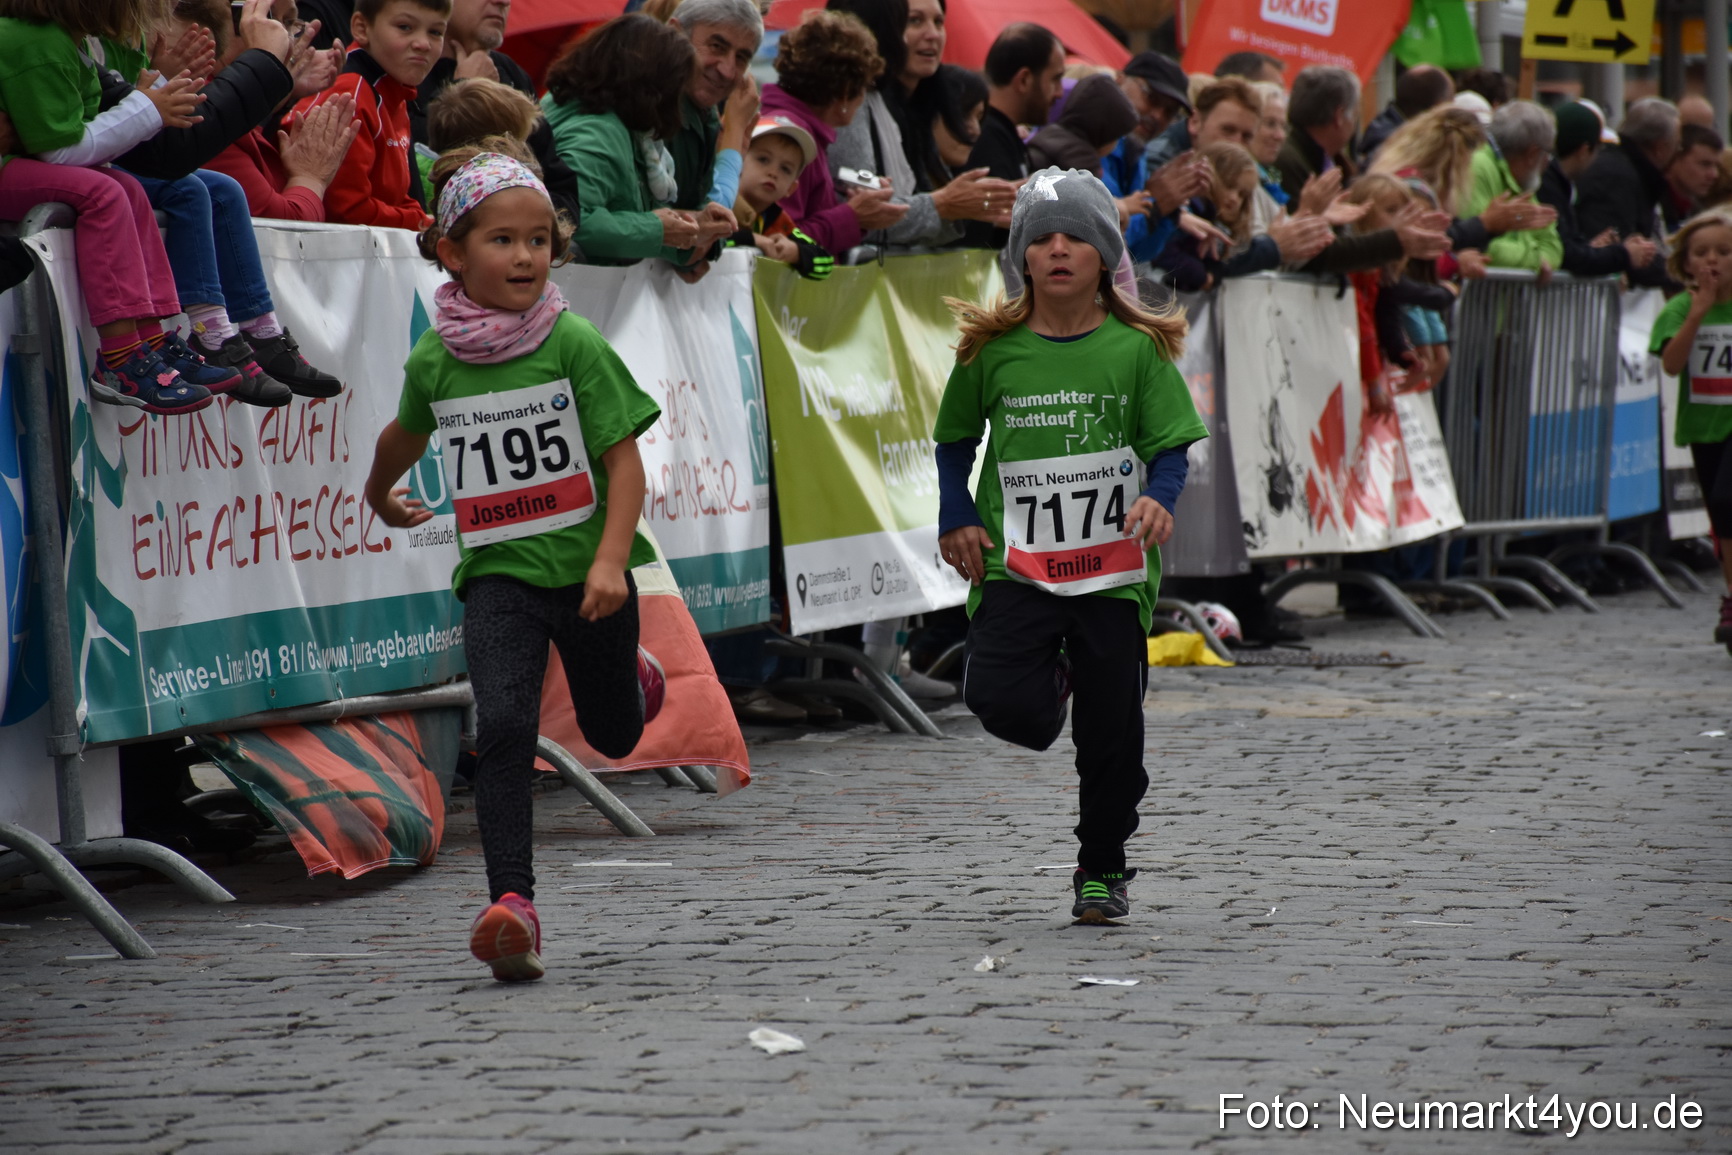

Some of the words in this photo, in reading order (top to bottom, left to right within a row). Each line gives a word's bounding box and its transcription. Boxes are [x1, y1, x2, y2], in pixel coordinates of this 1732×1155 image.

[1002, 390, 1095, 408] Neumarkter
[439, 413, 471, 430] PARTL
[473, 402, 546, 424] Neumarkt
[1005, 410, 1077, 428] Stadtlauf
[449, 418, 571, 491] 7195
[1004, 475, 1043, 489] PARTL
[1047, 466, 1115, 486] Neumarkt
[470, 493, 558, 526] Josefine
[1015, 483, 1128, 546] 7174
[1046, 554, 1102, 578] Emilia
